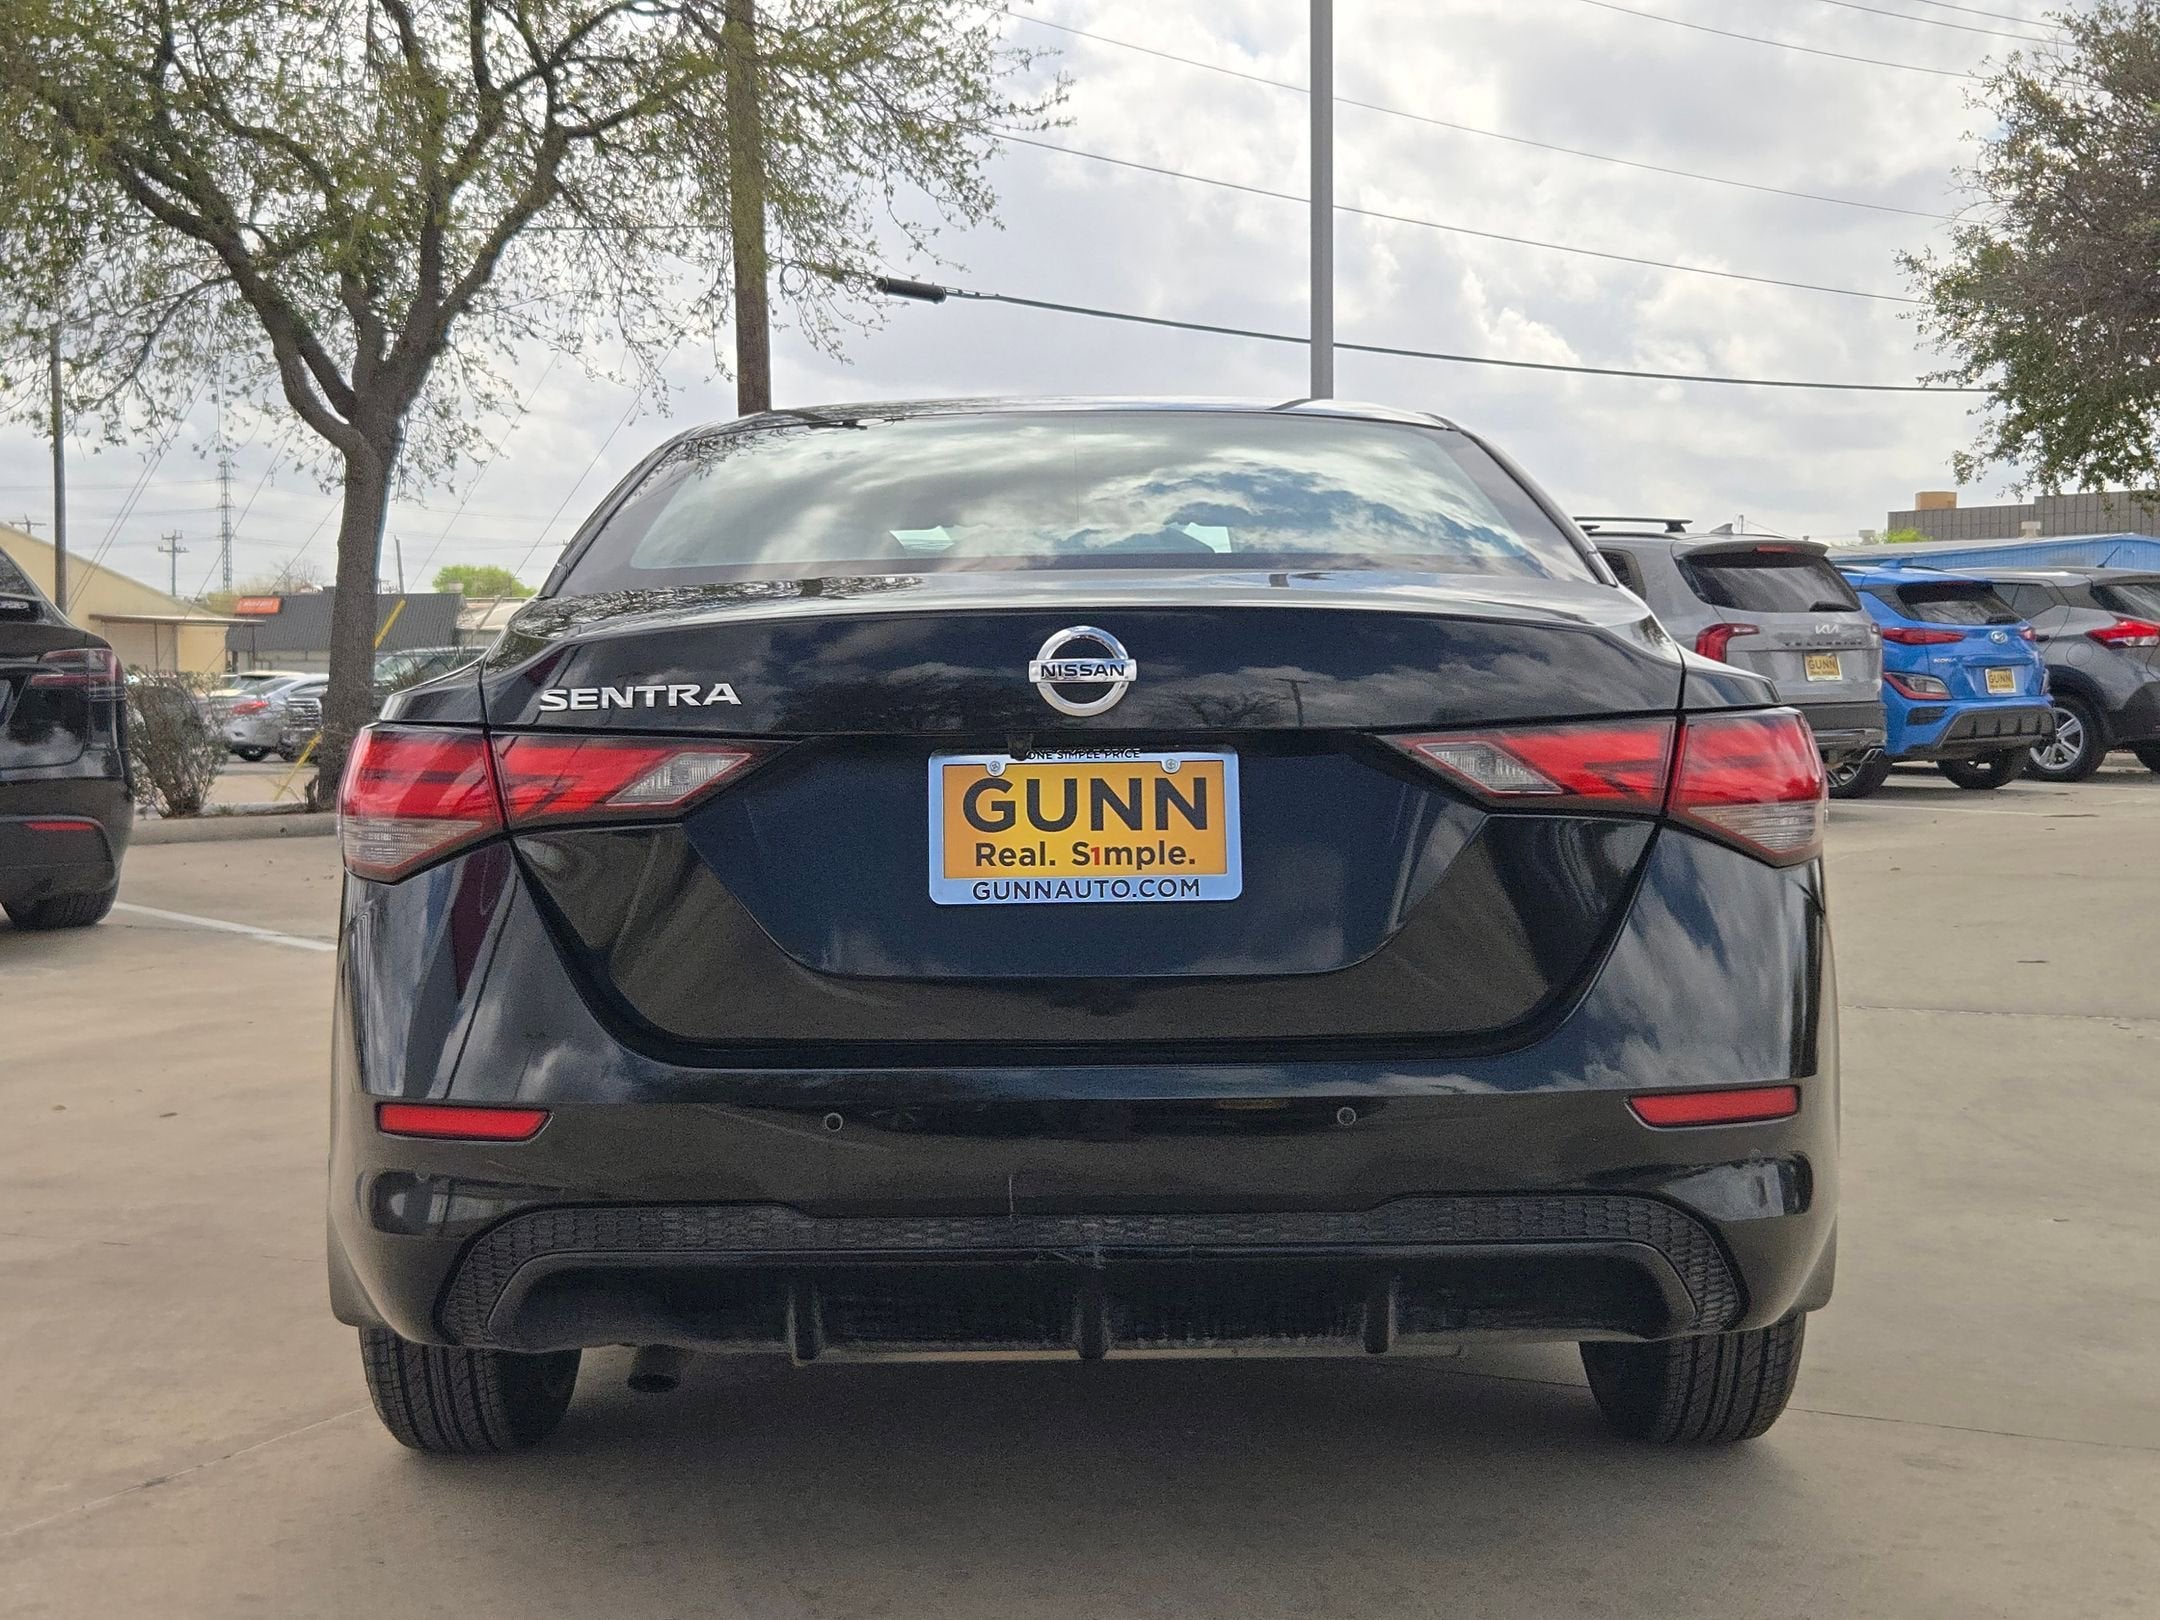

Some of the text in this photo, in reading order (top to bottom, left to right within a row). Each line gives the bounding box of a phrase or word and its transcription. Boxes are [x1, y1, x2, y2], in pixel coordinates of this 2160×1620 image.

[1041, 664, 1125, 677] NISSAN
[1808, 659, 1836, 669] GUNN
[1988, 670, 2012, 683] GUNN
[539, 683, 742, 711] SENTRA
[1026, 748, 1140, 760] ONE SIMPLE PRICE
[963, 777, 1208, 833] GUNN
[975, 840, 1196, 870] Real. S1mple.
[972, 878, 1200, 900] GUNNAUTO.COM
